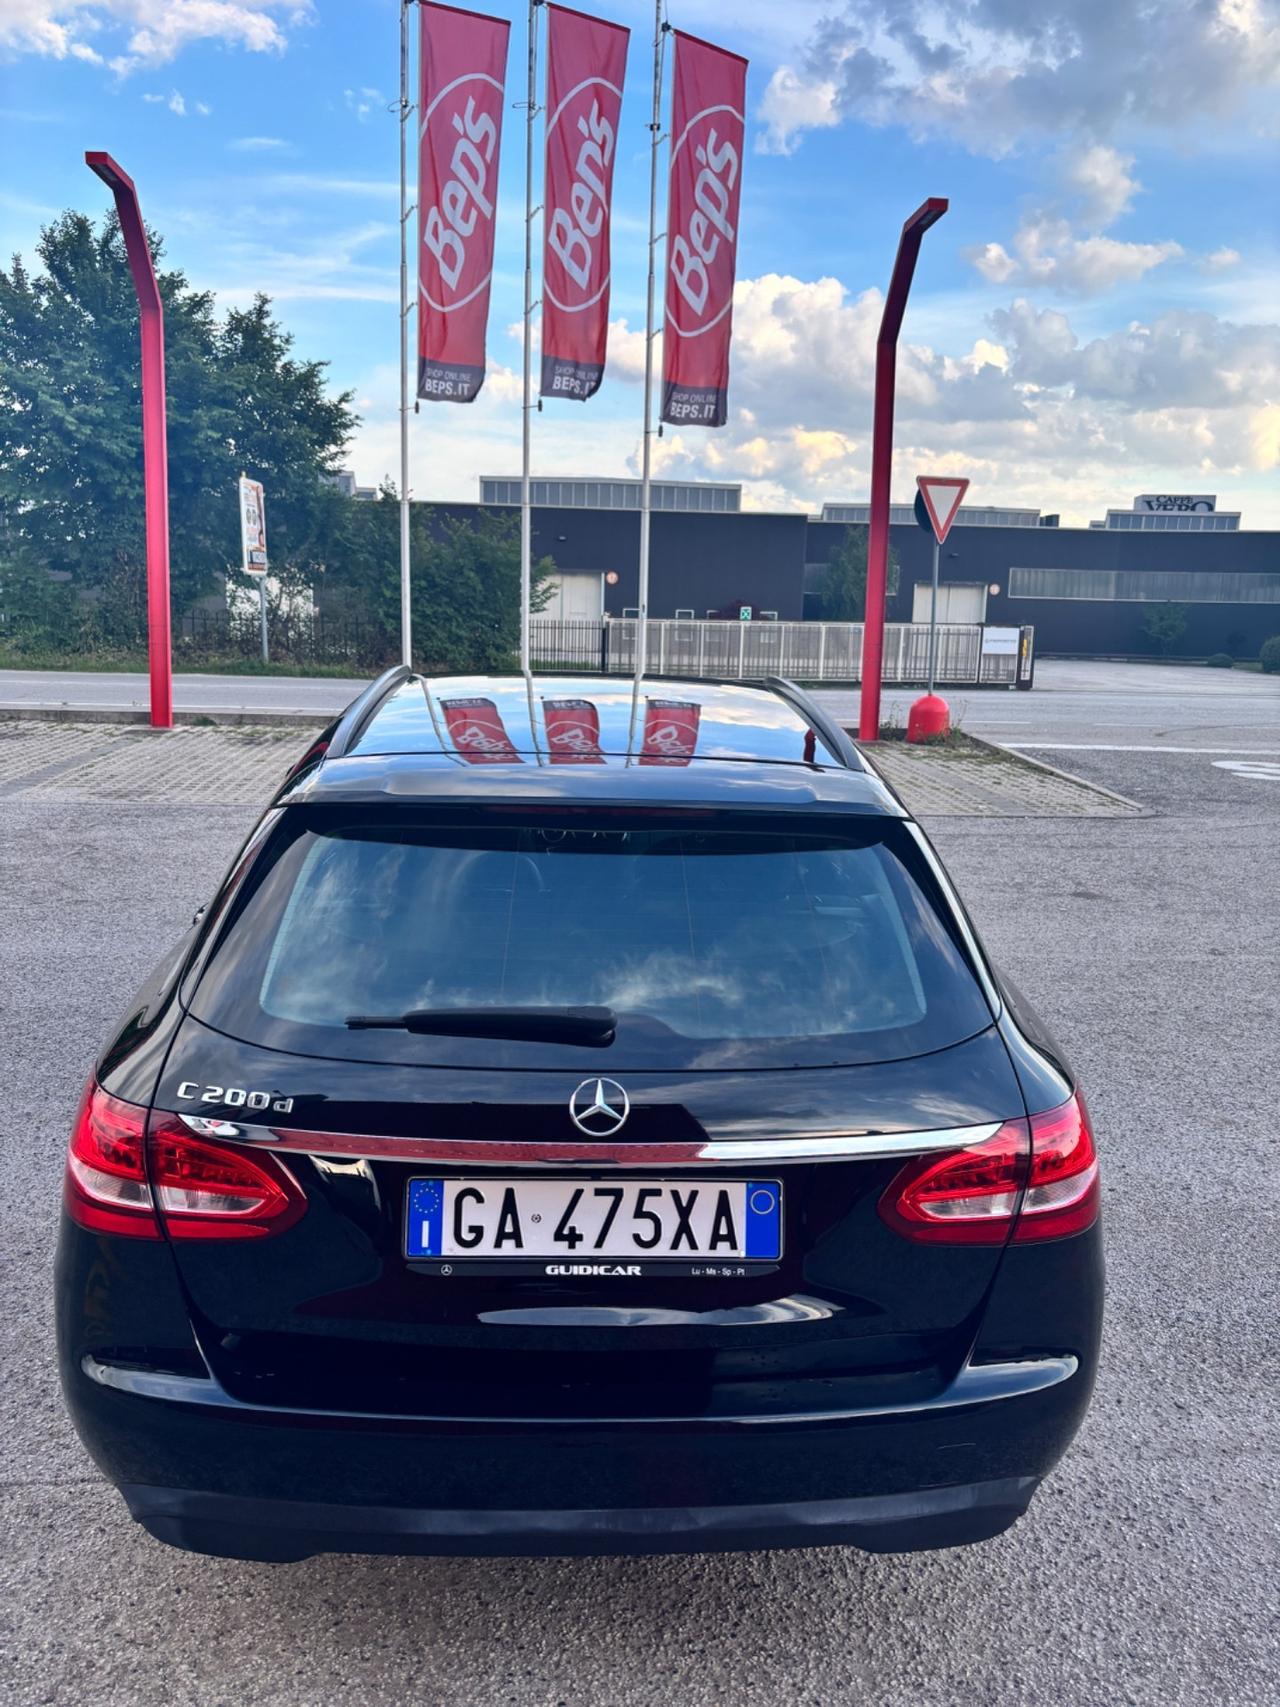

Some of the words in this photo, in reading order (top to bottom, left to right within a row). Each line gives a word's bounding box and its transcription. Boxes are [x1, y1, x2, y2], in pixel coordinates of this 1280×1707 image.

[425, 378, 470, 396] BEPS.IT
[670, 401, 716, 419] BEPS.IT
[453, 1187, 524, 1249] GA
[553, 1187, 738, 1251] 475XA
[545, 1264, 642, 1276] GUIDICAR
